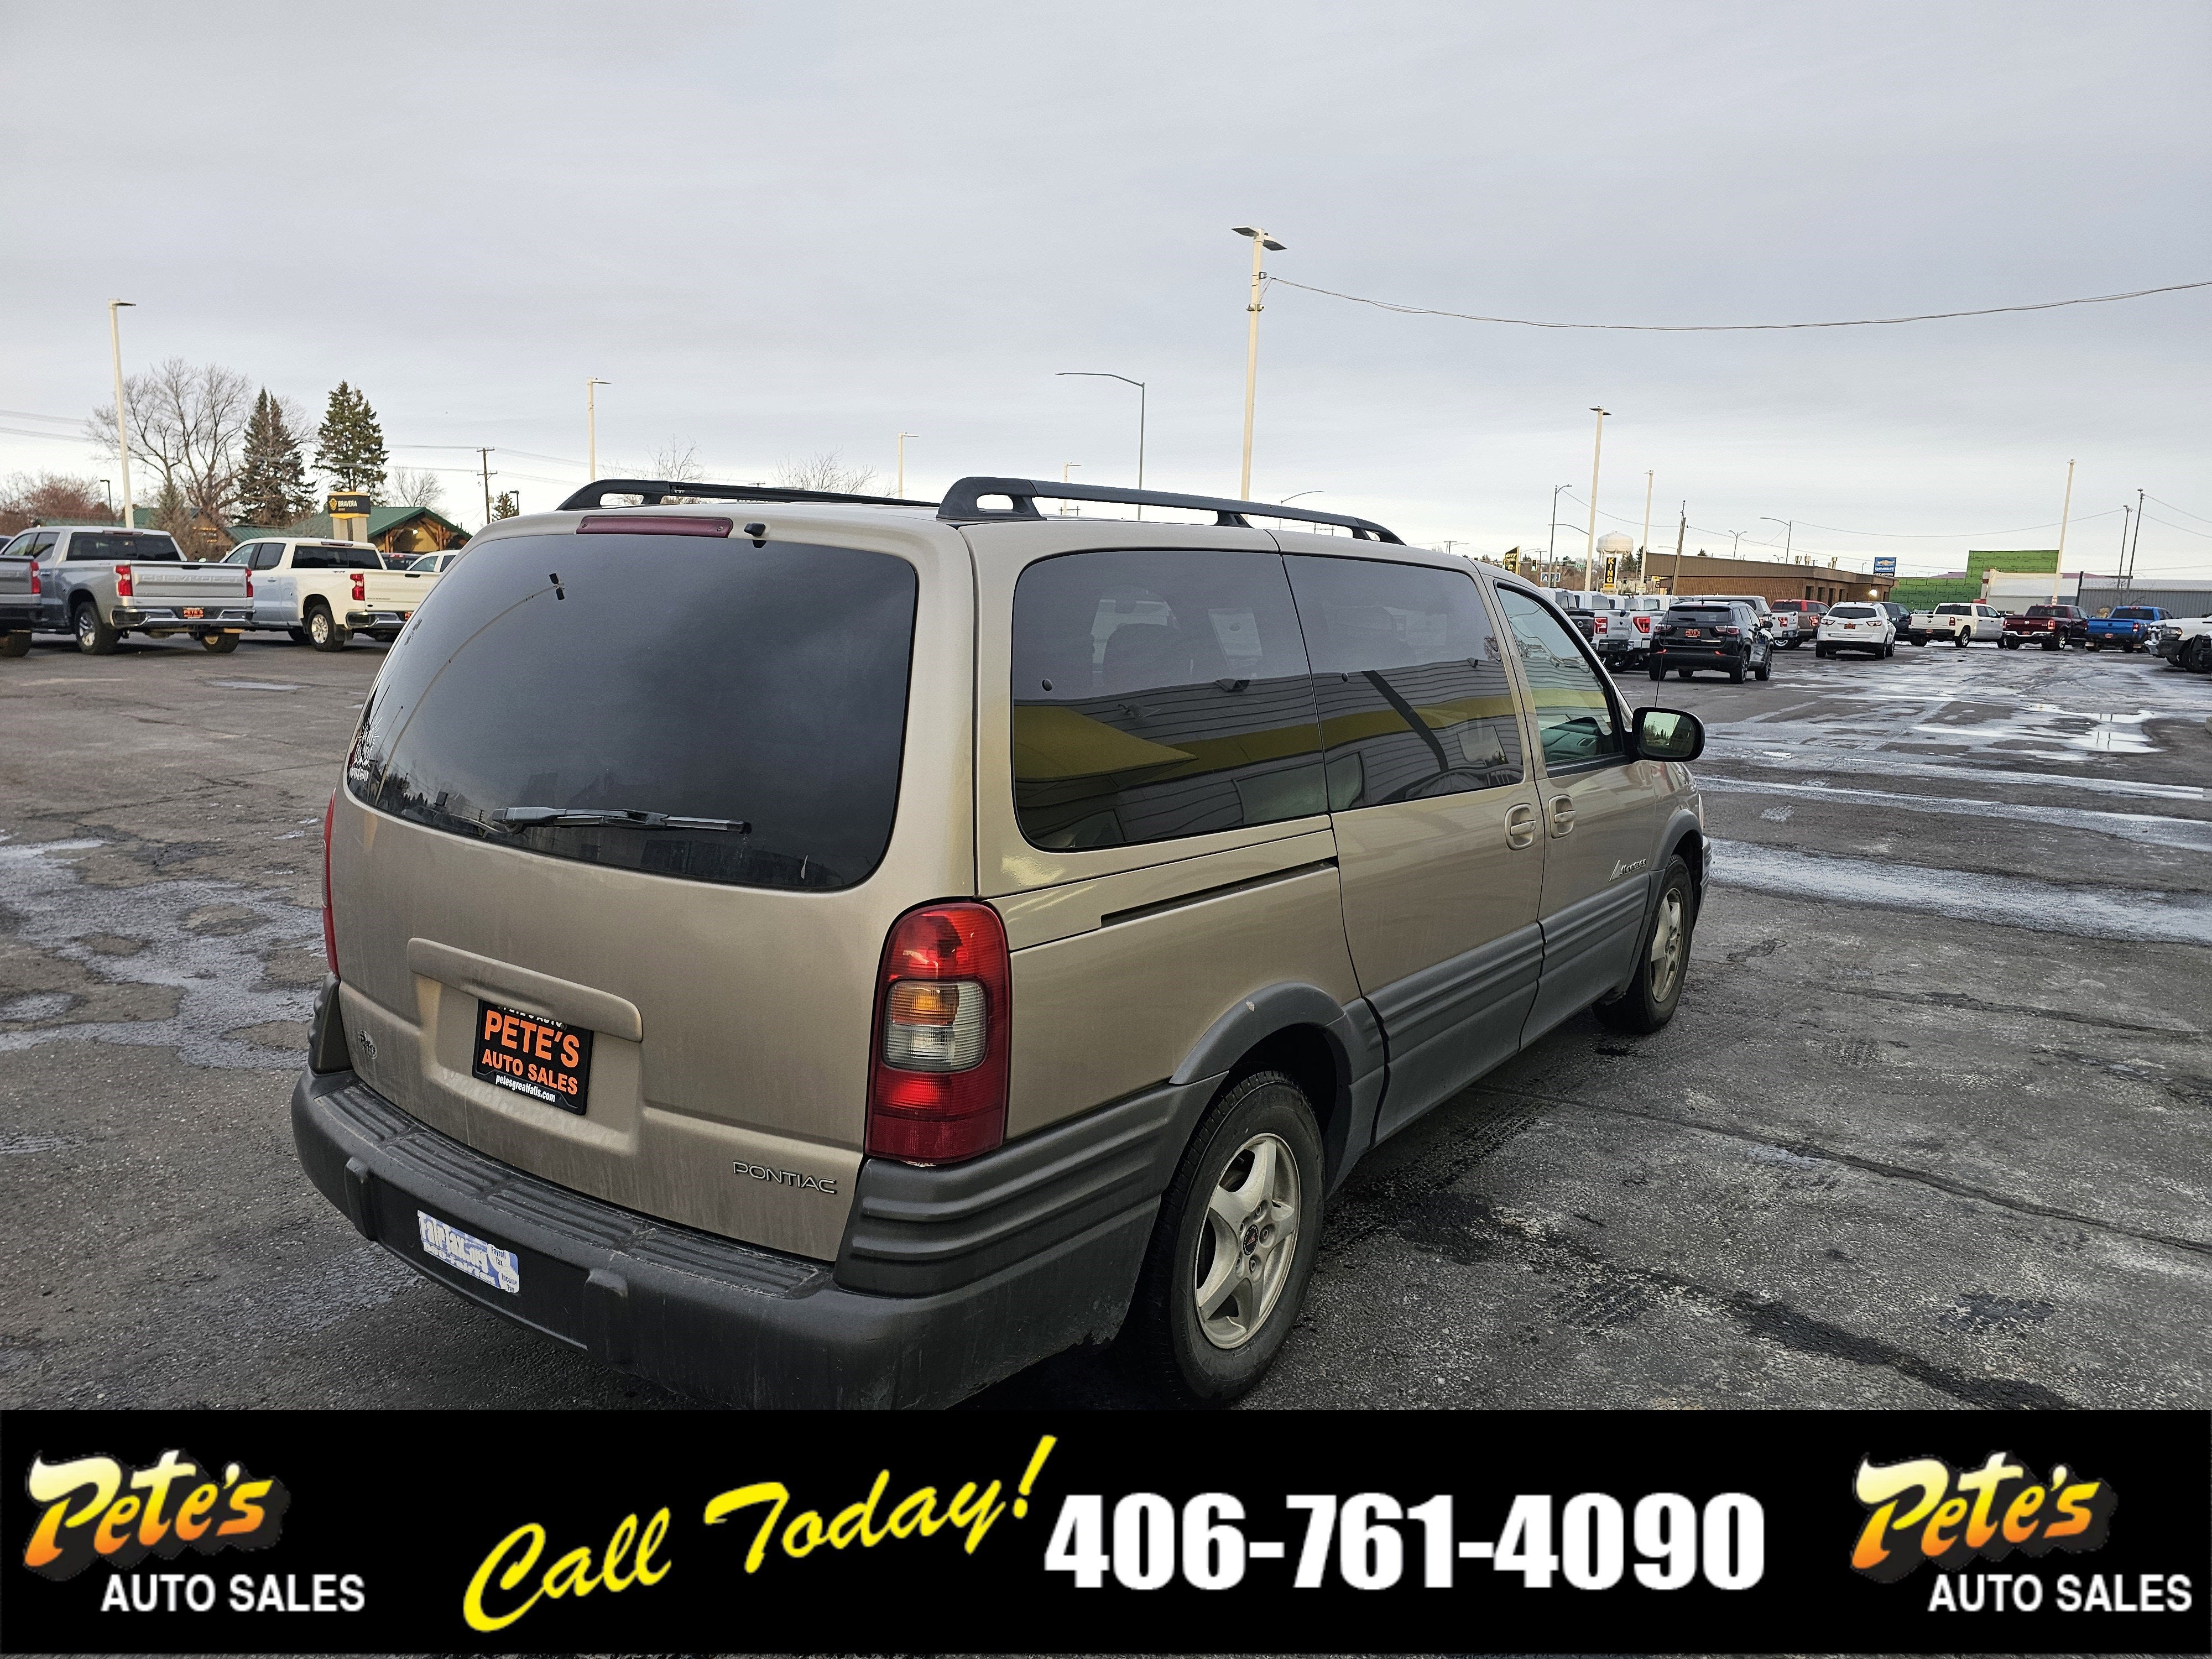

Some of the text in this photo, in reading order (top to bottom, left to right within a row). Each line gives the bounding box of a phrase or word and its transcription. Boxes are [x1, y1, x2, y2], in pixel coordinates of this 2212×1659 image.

[484, 1010, 580, 1068] PETE'S
[482, 1048, 578, 1095] AUTO SALES
[495, 1074, 556, 1103] petesgreatfalls.com
[733, 1161, 837, 1194] PONTIAC
[491, 1246, 506, 1259] Payroll
